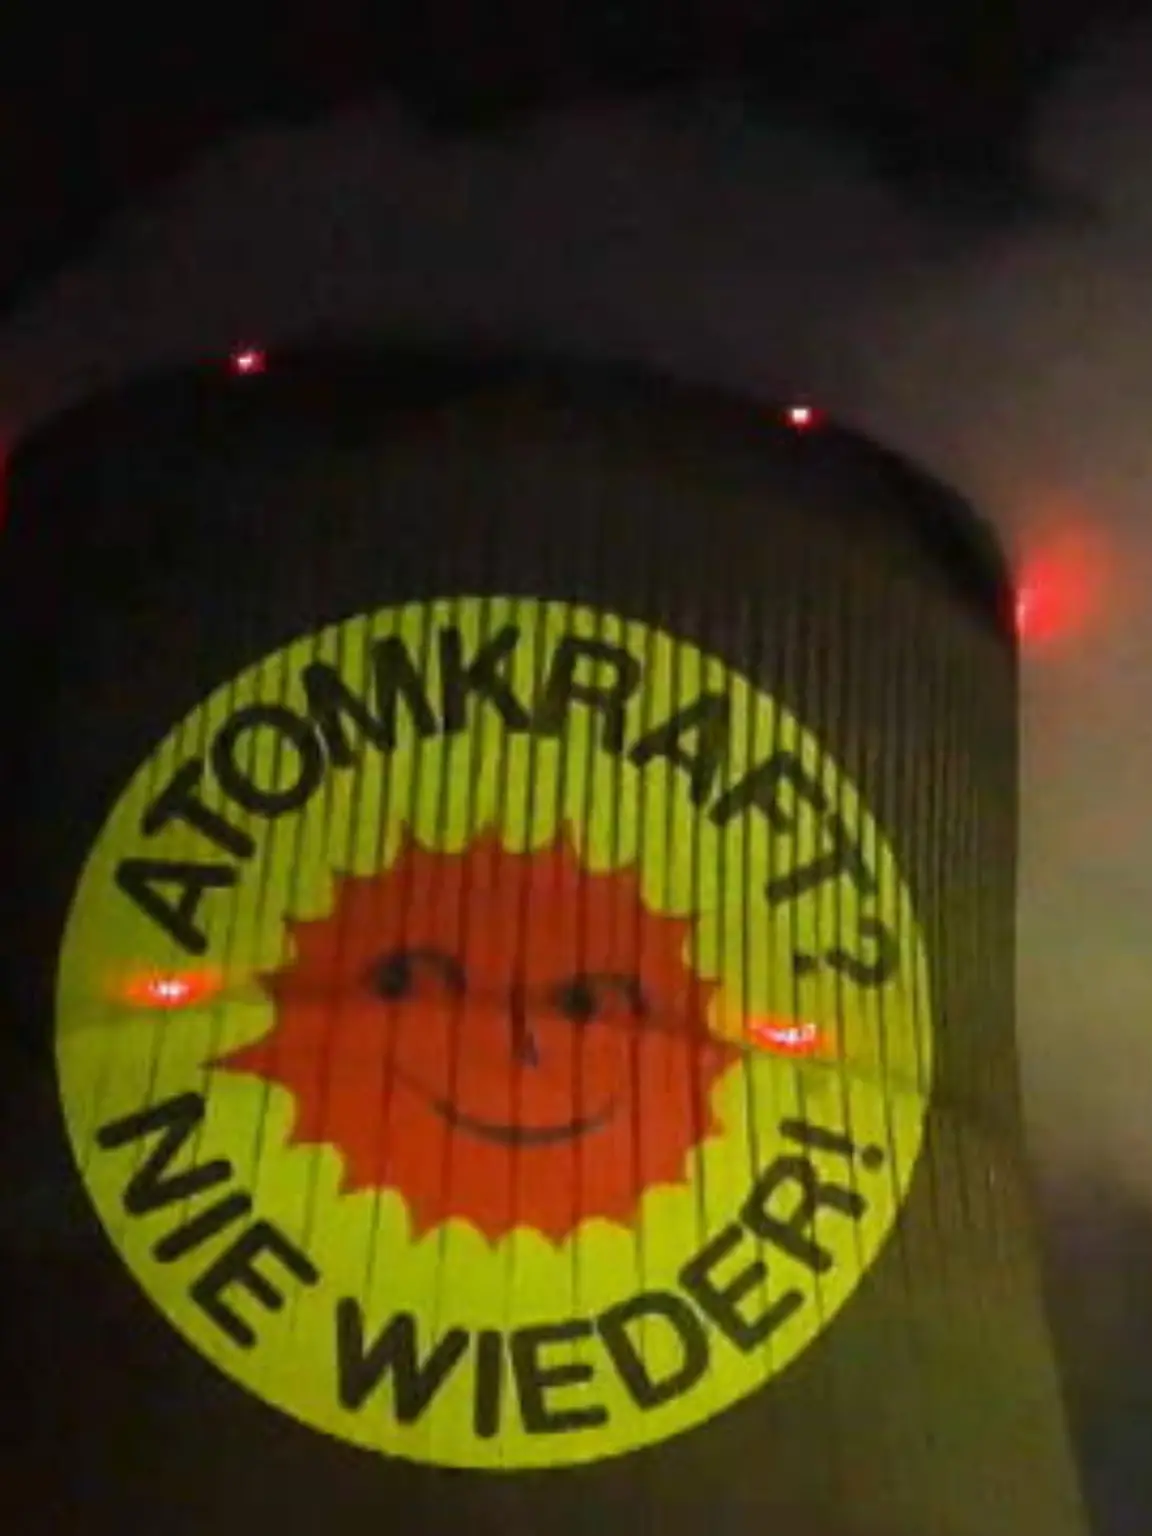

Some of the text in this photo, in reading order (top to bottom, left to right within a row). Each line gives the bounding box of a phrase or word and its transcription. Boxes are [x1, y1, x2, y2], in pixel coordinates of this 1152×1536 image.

[115, 626, 898, 988] ATOMKRAFT?
[97, 1091, 886, 1439] NIE WIEDER!
